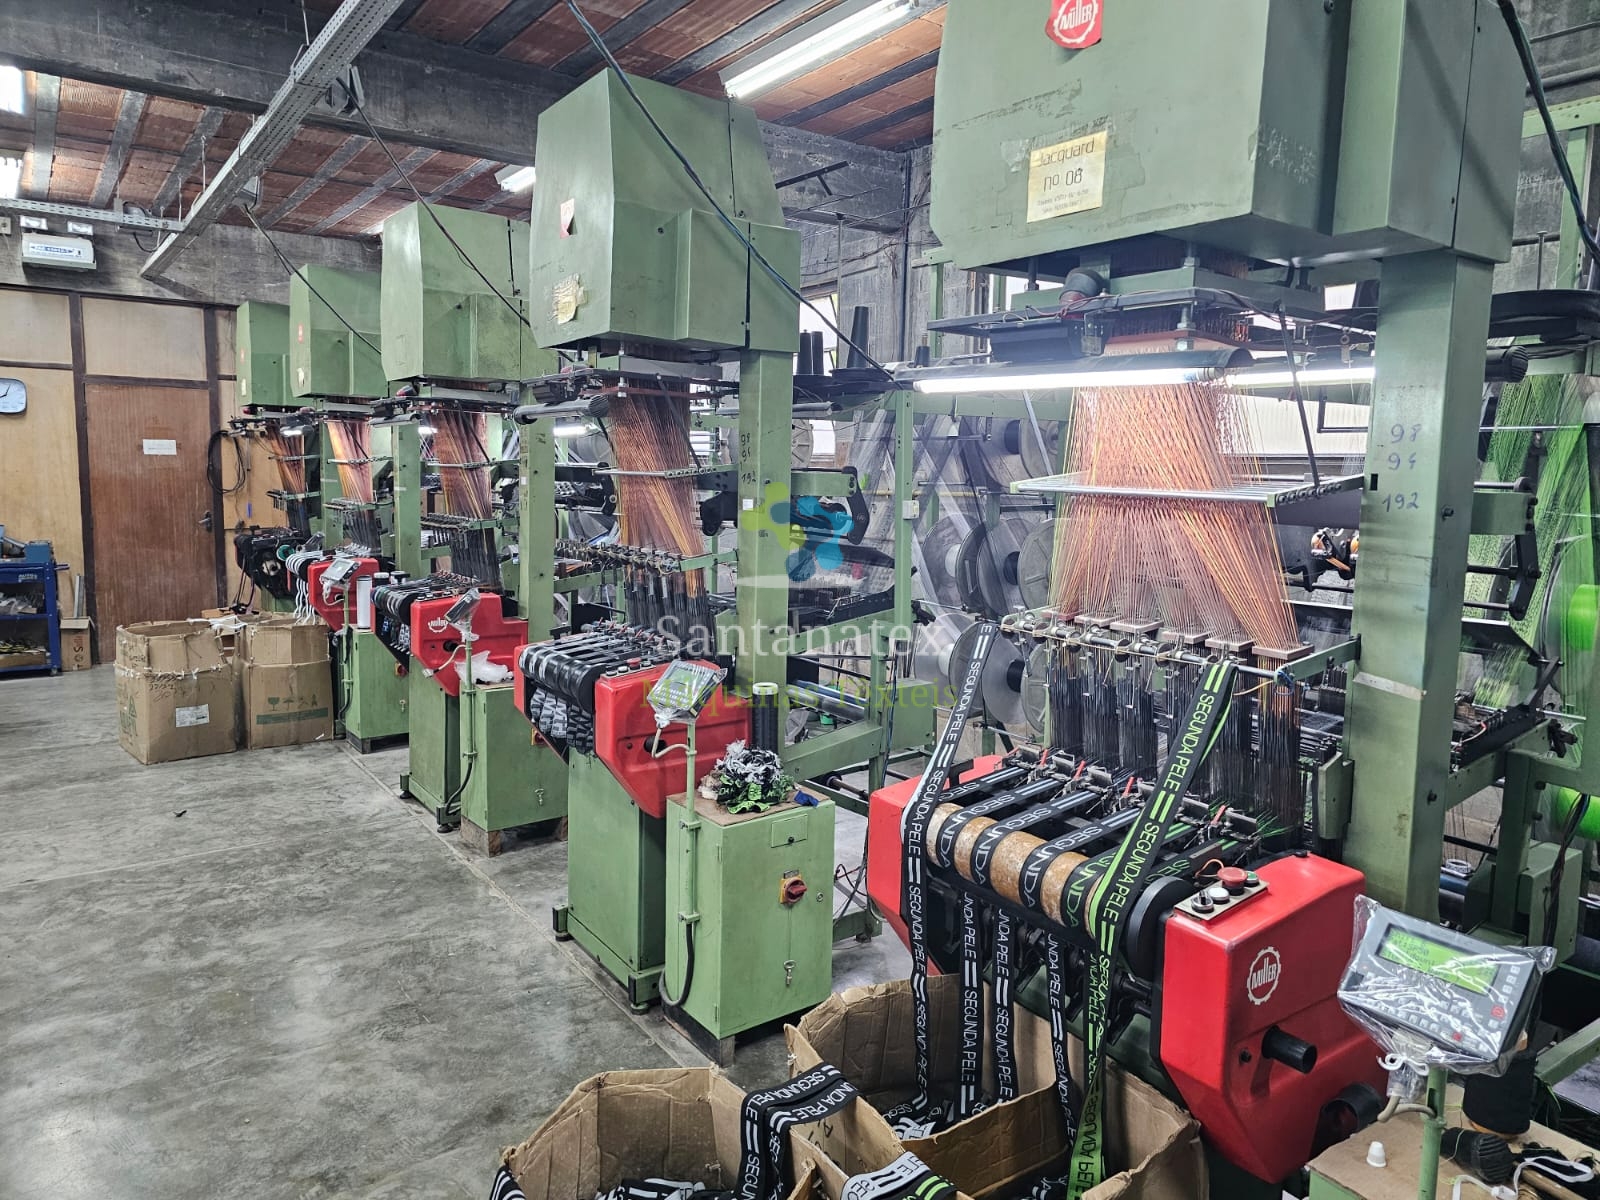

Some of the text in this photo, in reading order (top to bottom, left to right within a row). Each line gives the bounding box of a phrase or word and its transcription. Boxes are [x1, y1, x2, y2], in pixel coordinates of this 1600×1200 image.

[1065, 168, 1083, 186] 08
[1382, 491, 1420, 512] 192
[945, 661, 981, 742] SEGUNDA PELE
[1164, 693, 1214, 793] SEGUNDA PELE
[908, 769, 944, 858] SEGUNDA PELE
[940, 794, 1015, 868] SEGUNDA
[975, 808, 1051, 885] SEGUNDA
[1023, 826, 1103, 908] SEGUNDA
[1101, 822, 1160, 923] SEGUNDA PELE
[909, 884, 926, 977] SEGUNDA PELE
[963, 923, 977, 960] PELE
[997, 944, 1009, 979] PELE
[1049, 971, 1061, 1012] PELE
[961, 989, 978, 1087] SEGUNDA PELE
[996, 1001, 1013, 1098] SEGUNDA PELE
[746, 1071, 826, 1121] SEGUNDA PELE
[791, 1101, 829, 1119] PELE
